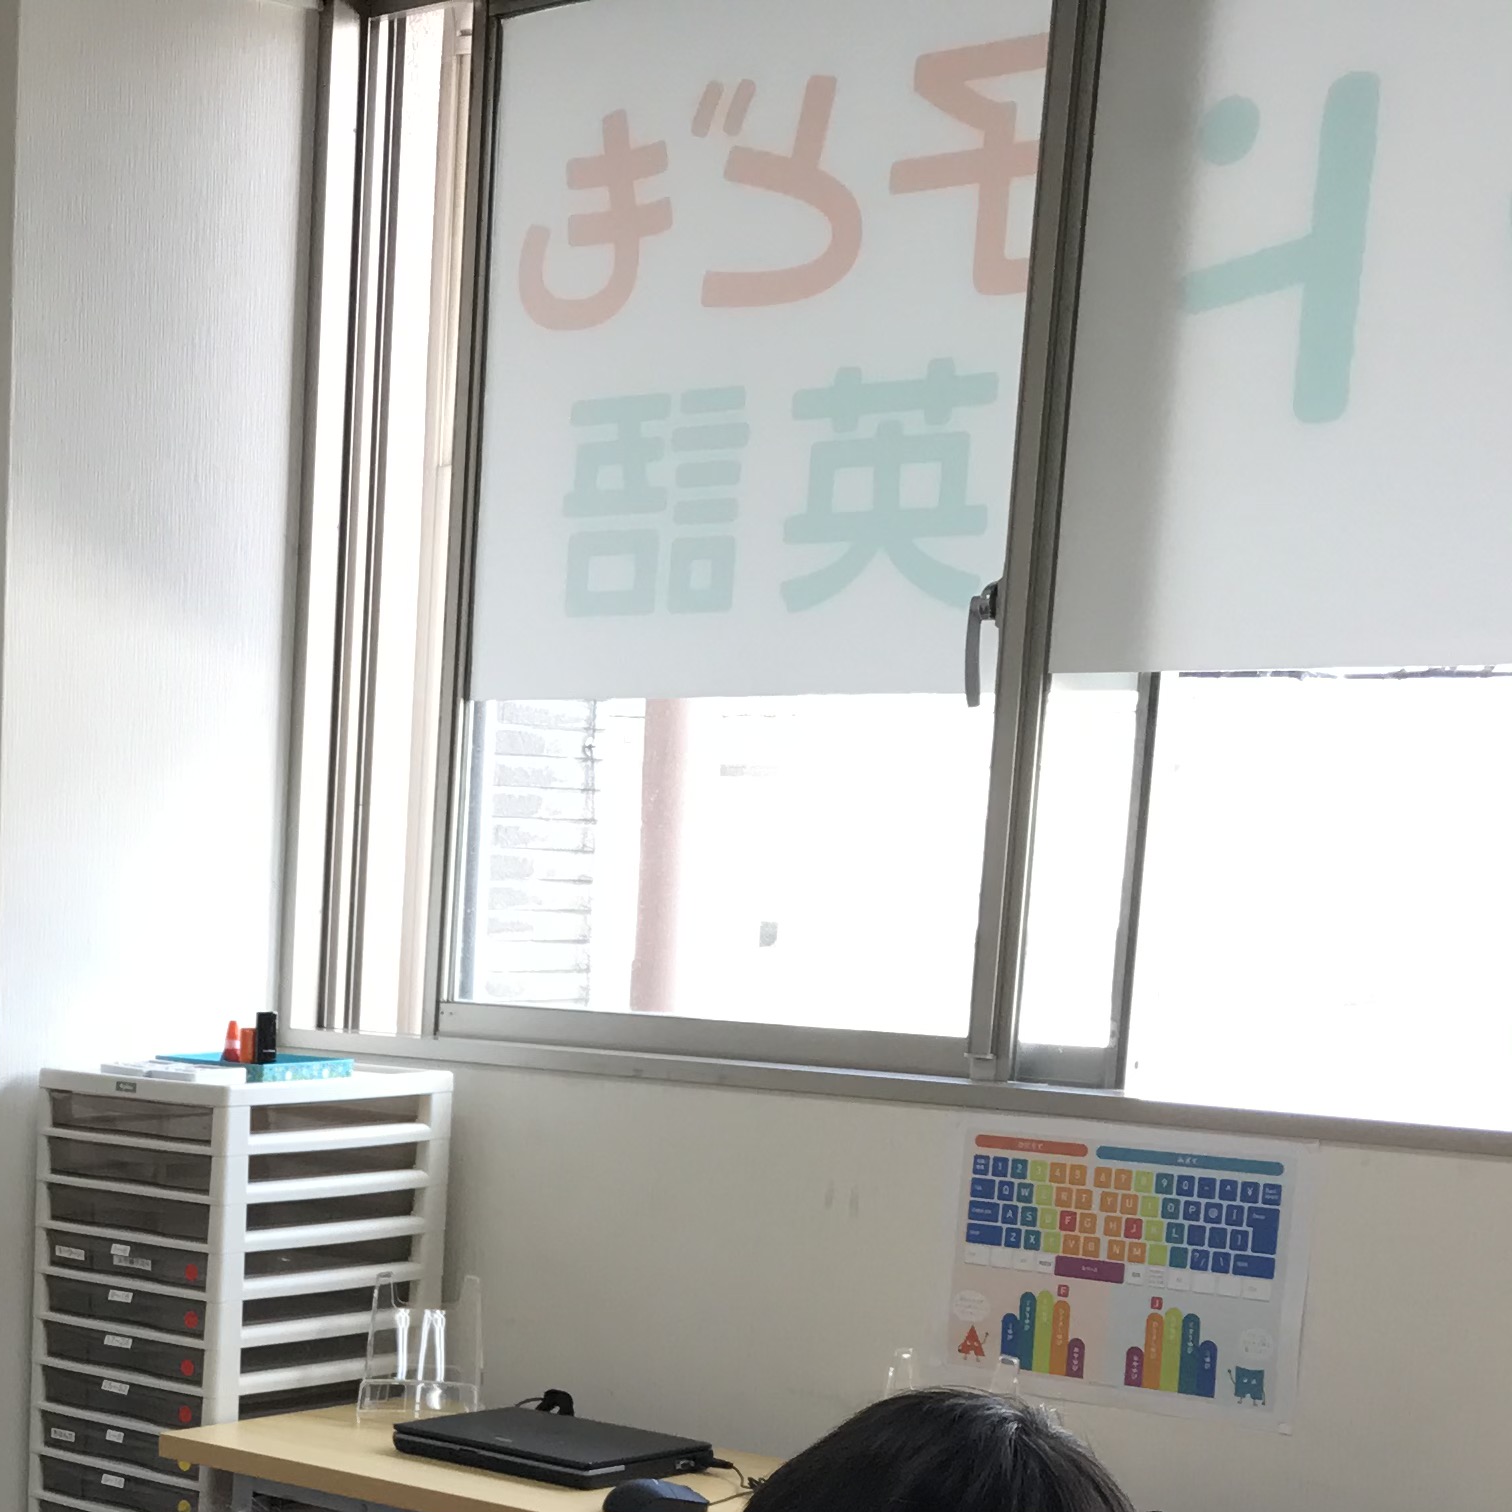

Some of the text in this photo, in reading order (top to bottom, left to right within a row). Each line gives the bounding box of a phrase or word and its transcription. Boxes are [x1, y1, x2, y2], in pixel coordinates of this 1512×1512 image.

[1016, 1163, 1022, 1173] 2
[1020, 1187, 1031, 1197] W
[1126, 1198, 1133, 1207] U
[1188, 1205, 1196, 1215] P
[1006, 1209, 1013, 1219] A
[1025, 1211, 1033, 1222] S
[1065, 1215, 1072, 1225] F
[1131, 1223, 1136, 1233] J
[1171, 1229, 1179, 1239] L
[1009, 1232, 1017, 1242] Z
[1029, 1234, 1036, 1244] X
[1112, 1244, 1120, 1254] N
[1060, 1286, 1068, 1295] F
